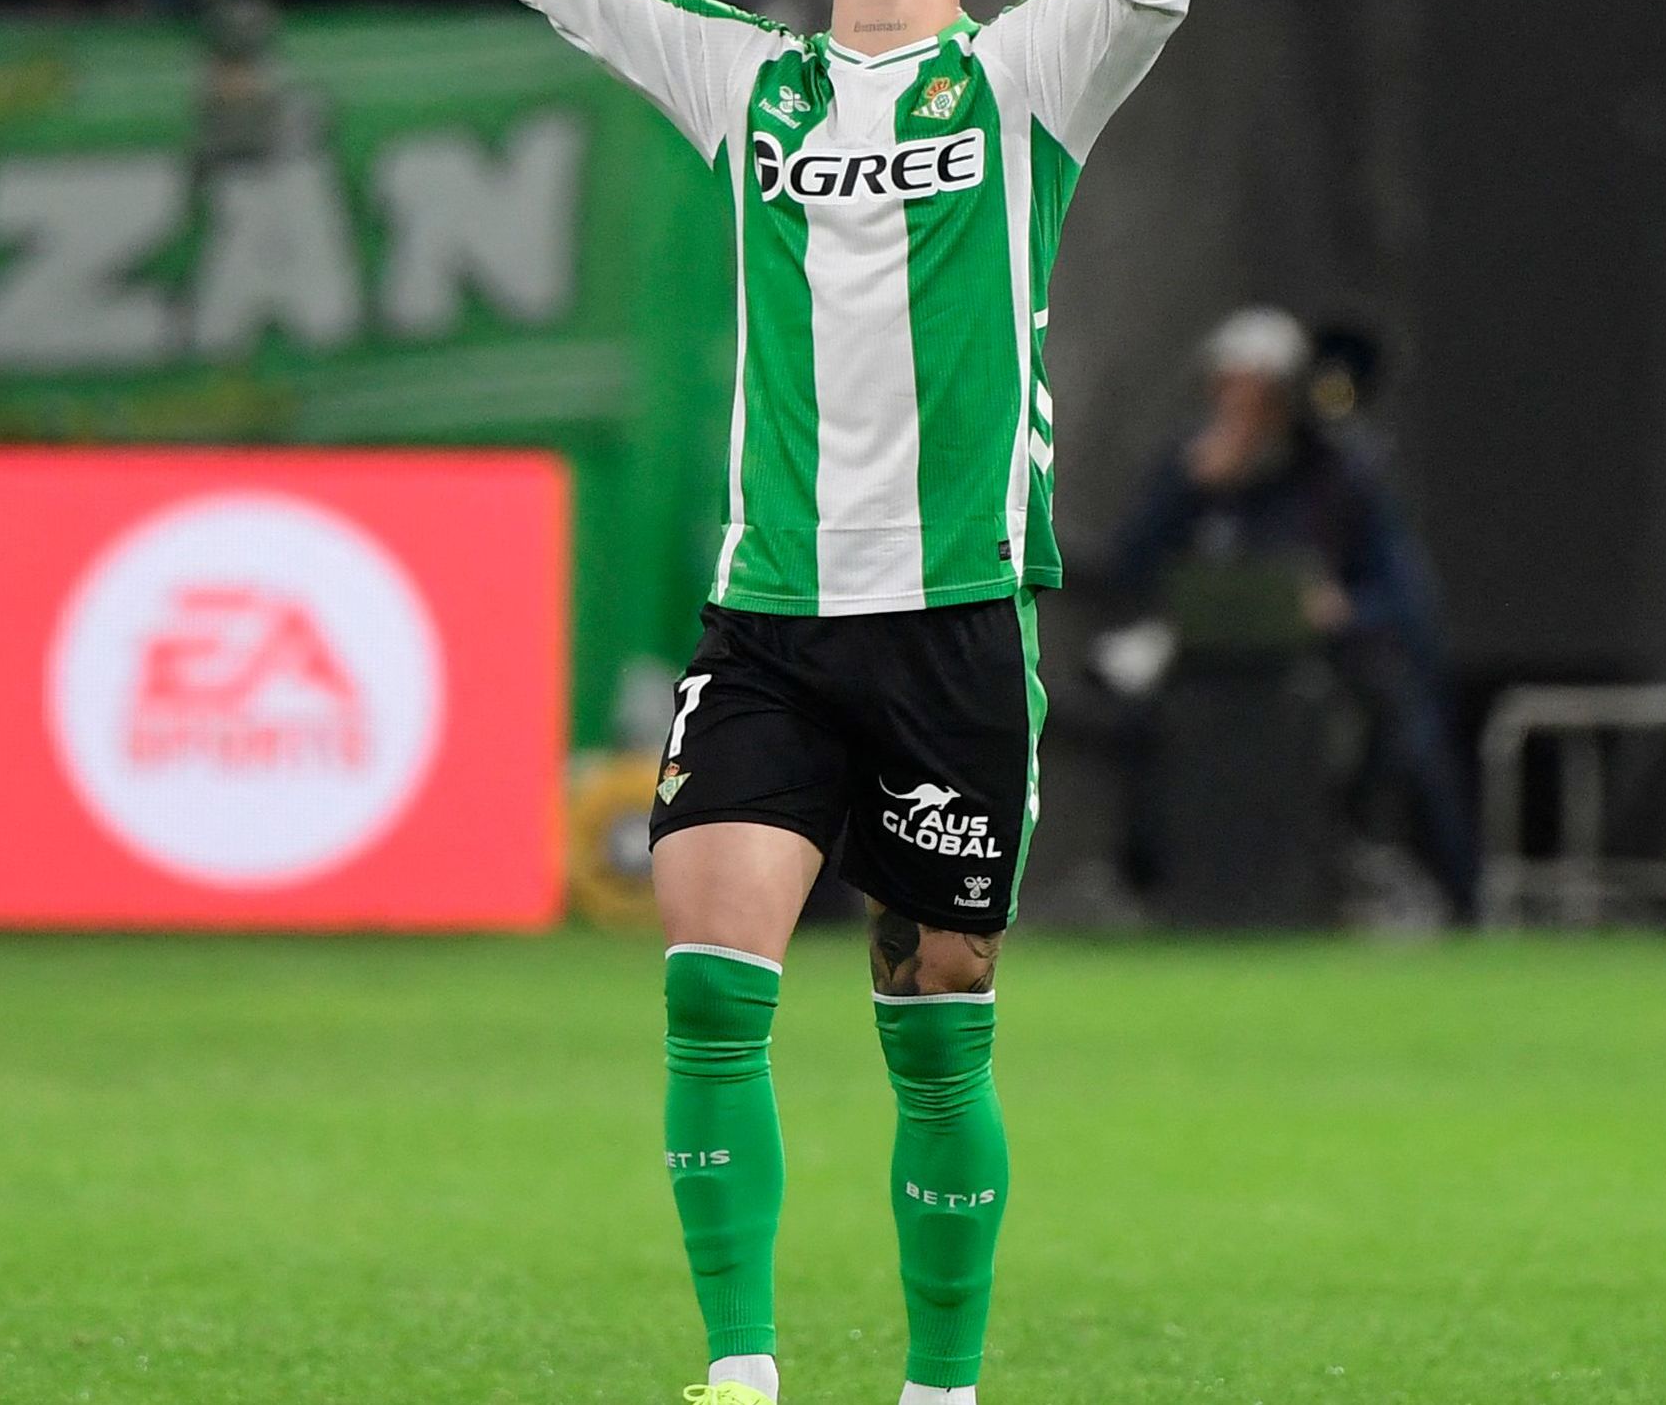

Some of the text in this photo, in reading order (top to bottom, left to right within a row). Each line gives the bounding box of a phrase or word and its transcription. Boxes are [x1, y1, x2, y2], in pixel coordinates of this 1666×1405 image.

[790, 136, 976, 197] GREE
[138, 583, 359, 715] EA
[883, 810, 1002, 858] GLOBAL
[919, 810, 989, 837] AUS
[665, 1149, 730, 1168] ETIS
[906, 1181, 996, 1208] BETIS
